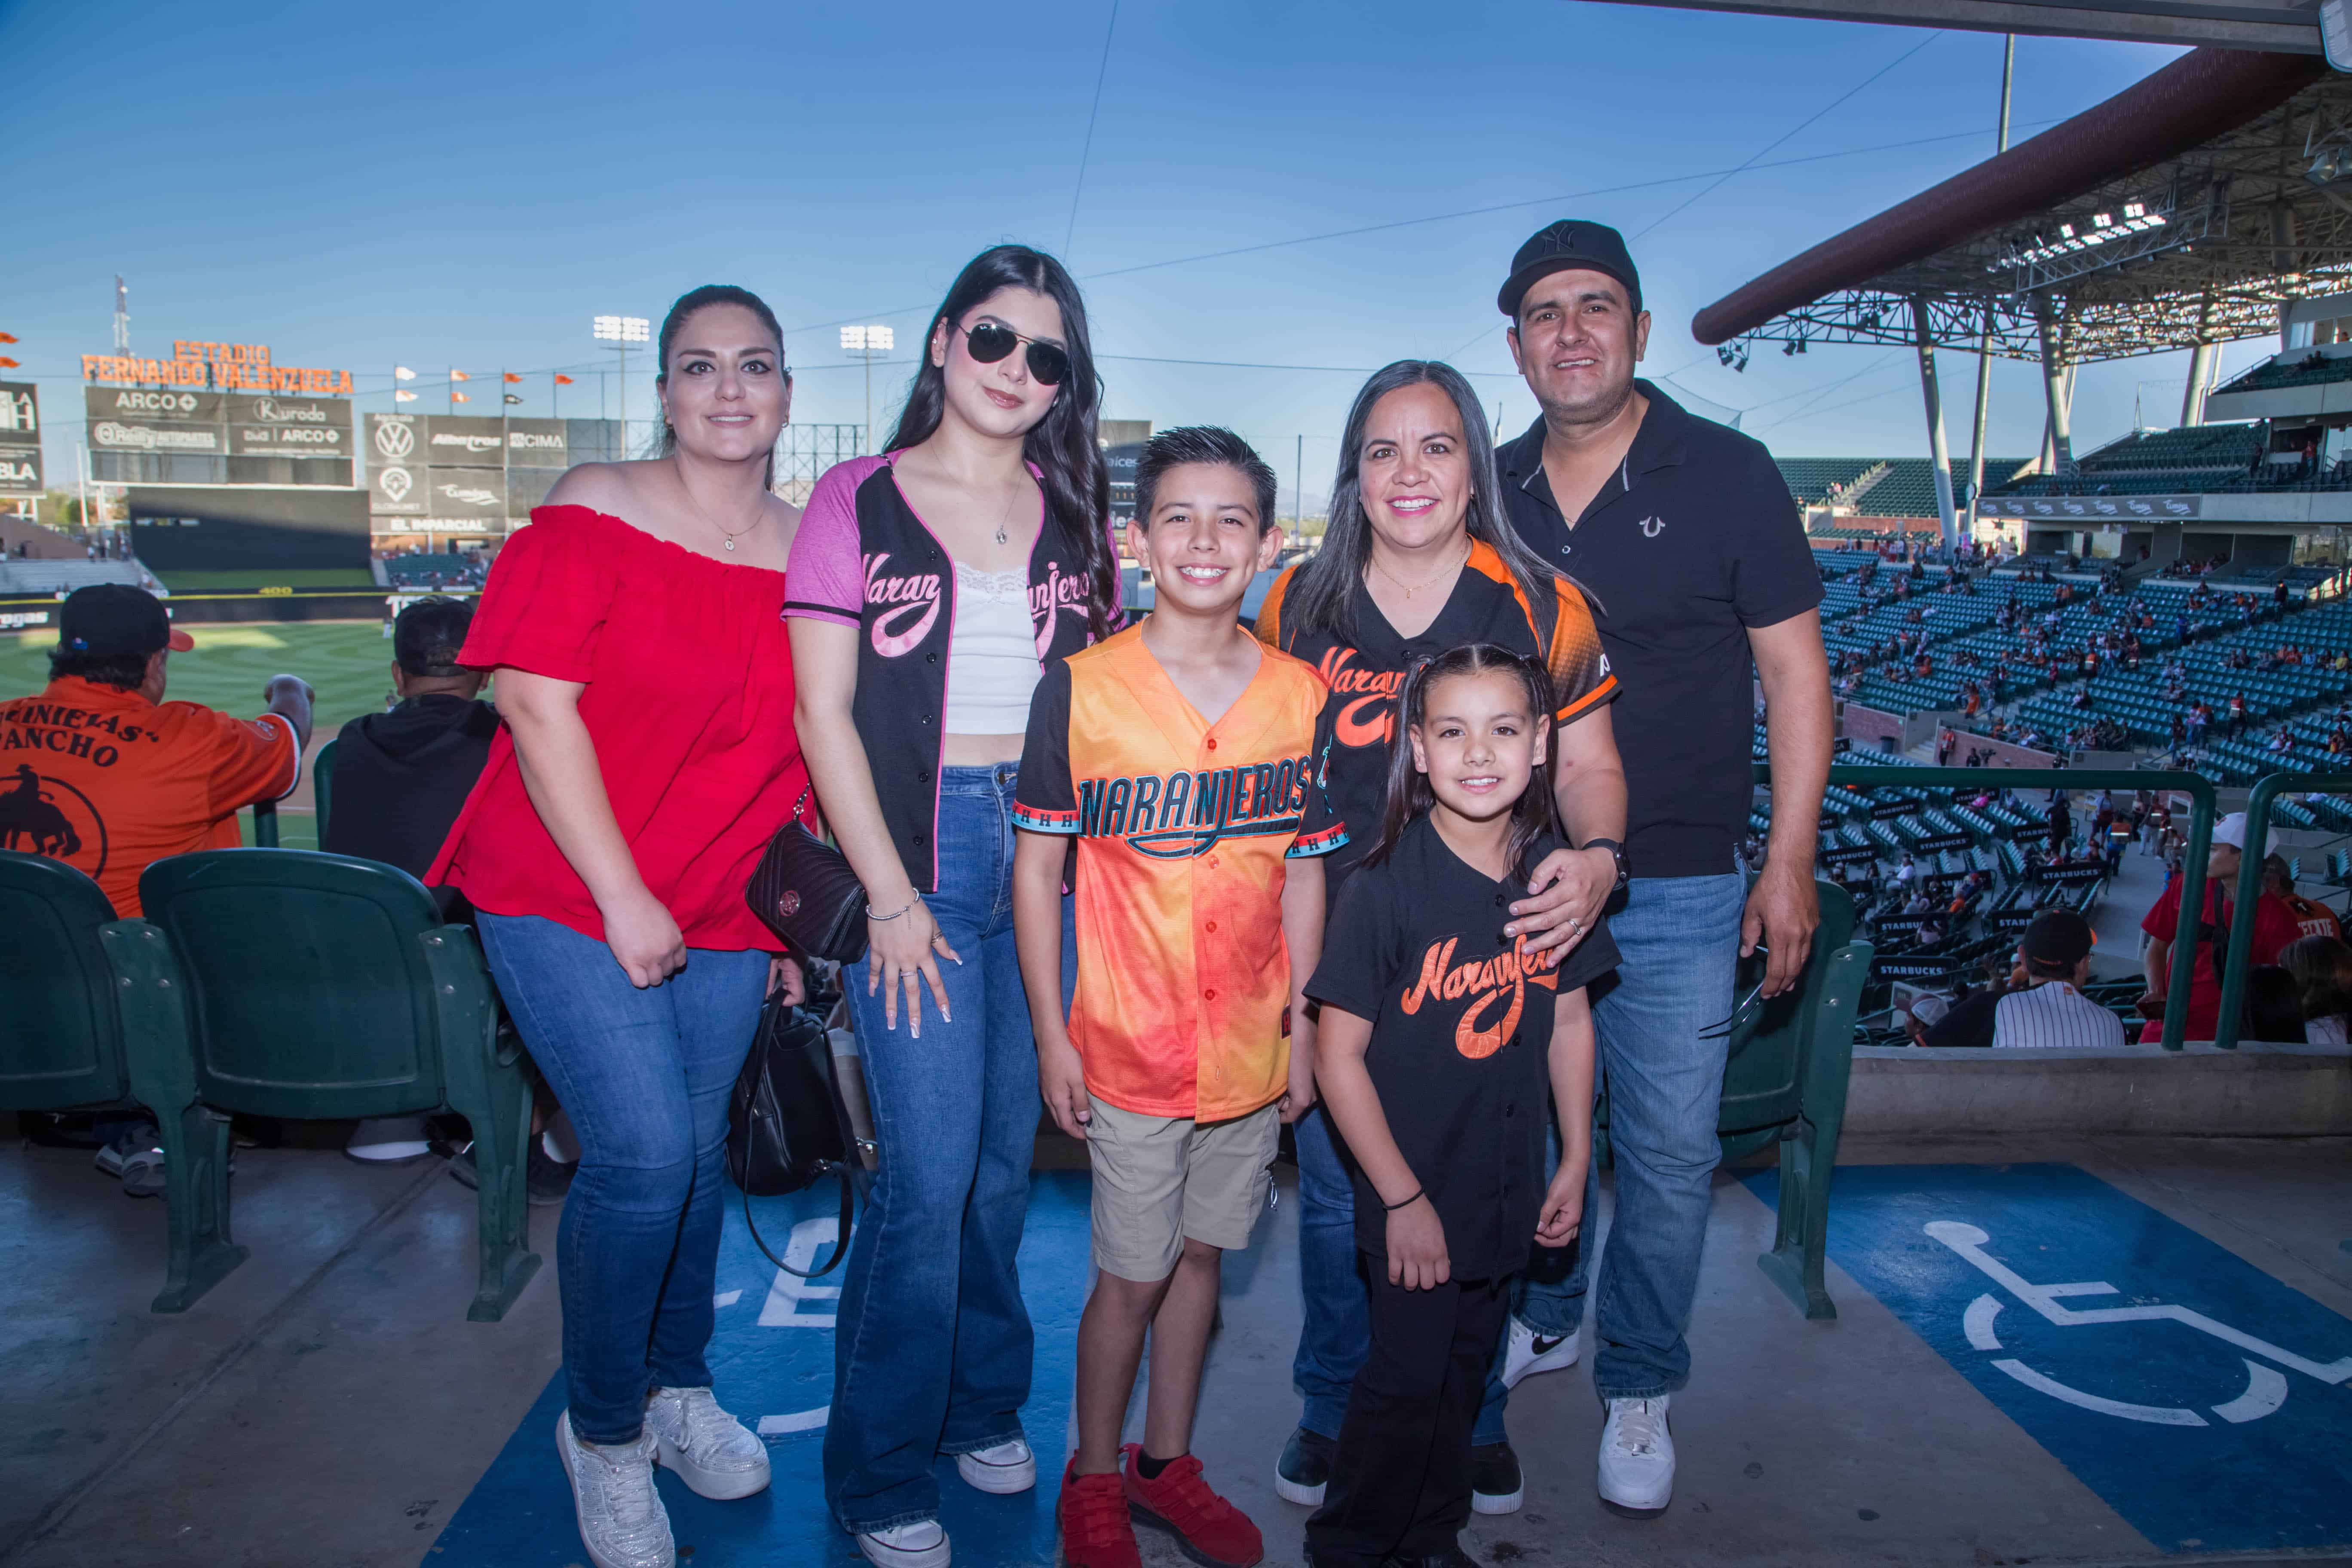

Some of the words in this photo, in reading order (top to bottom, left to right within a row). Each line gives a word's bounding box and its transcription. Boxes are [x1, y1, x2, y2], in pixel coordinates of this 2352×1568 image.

[174, 340, 270, 365] ESTADIO
[81, 354, 206, 386] FERNANDO
[211, 362, 354, 394] VALENZUELA
[116, 392, 177, 410] ARCO
[260, 400, 326, 422] Kuroda
[282, 429, 325, 442] ARCO
[525, 434, 564, 447] CIMA
[391, 519, 410, 531] EL
[411, 519, 487, 532] IMPARCIAL
[1079, 755, 1312, 859] NARANJEROS
[1874, 803, 1915, 816] STARBUCKS
[1021, 809, 1031, 824] H
[1039, 813, 1052, 827] H
[1061, 814, 1073, 827] H
[1307, 837, 1320, 851] H
[1327, 831, 1339, 845] H
[1920, 837, 1967, 851] STARBUCKS
[1827, 850, 1873, 862] STARBUCKS
[2042, 869, 2098, 880] STARBUCKS
[1880, 965, 1943, 975] STARBUCKS
